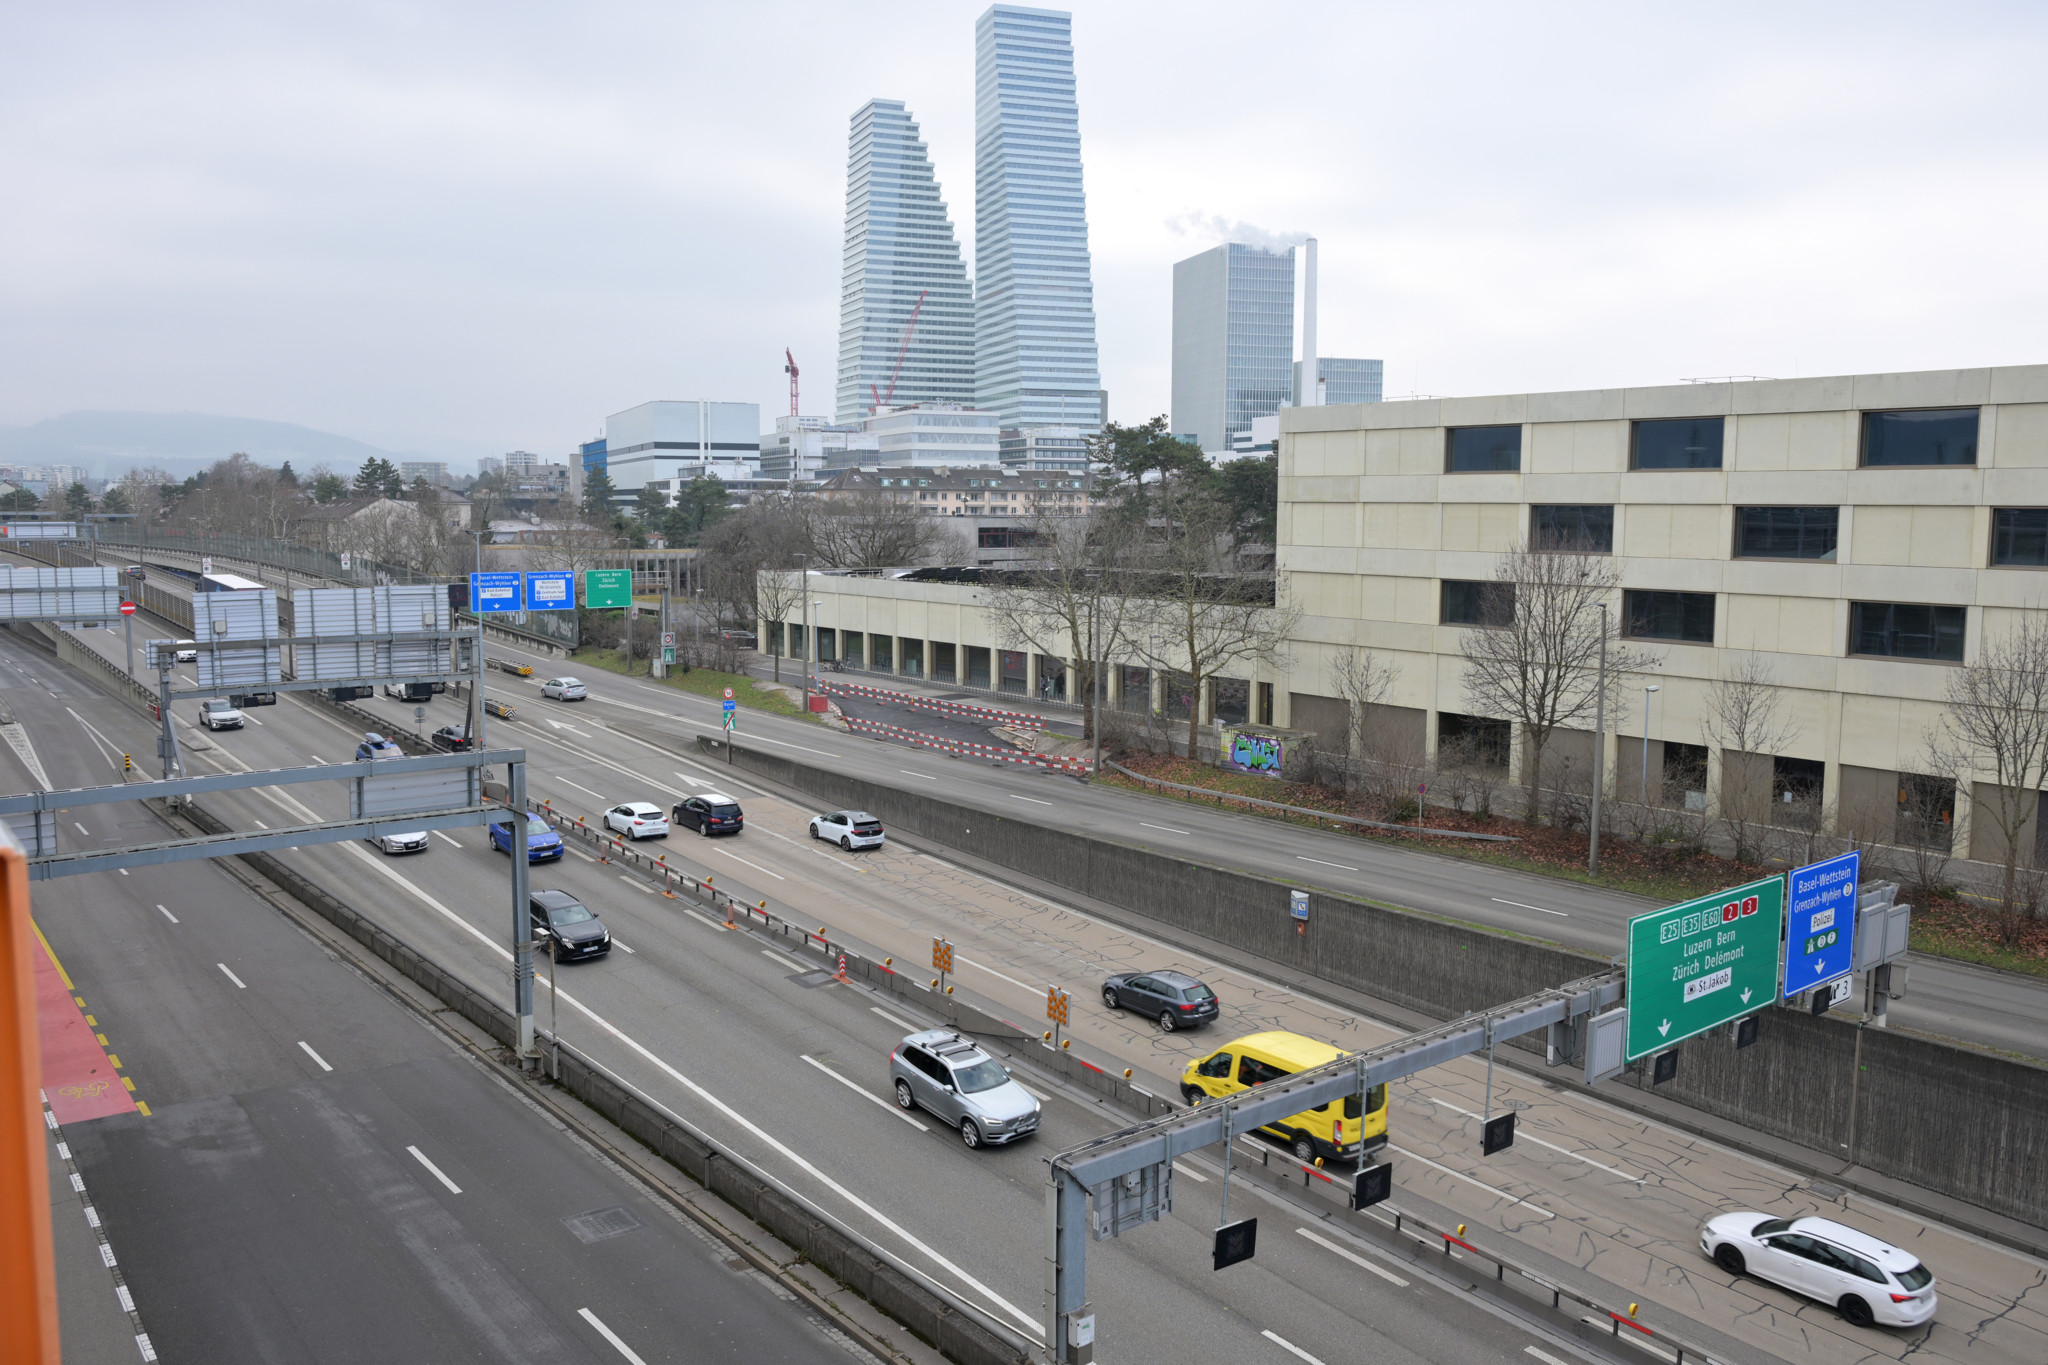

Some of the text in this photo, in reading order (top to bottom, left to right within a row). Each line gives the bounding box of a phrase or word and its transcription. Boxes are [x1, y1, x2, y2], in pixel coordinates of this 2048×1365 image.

[1798, 865, 1851, 894] Basel-Wettstein
[1728, 906, 1733, 919] 2
[1747, 900, 1752, 913] 3
[1794, 887, 1841, 913] Grenzach-Wyhlen
[1812, 910, 1833, 928] Polizei
[1683, 930, 1736, 957] Luzern Bern
[1672, 944, 1744, 981] Zürich Delémont
[1843, 980, 1848, 996] 3
